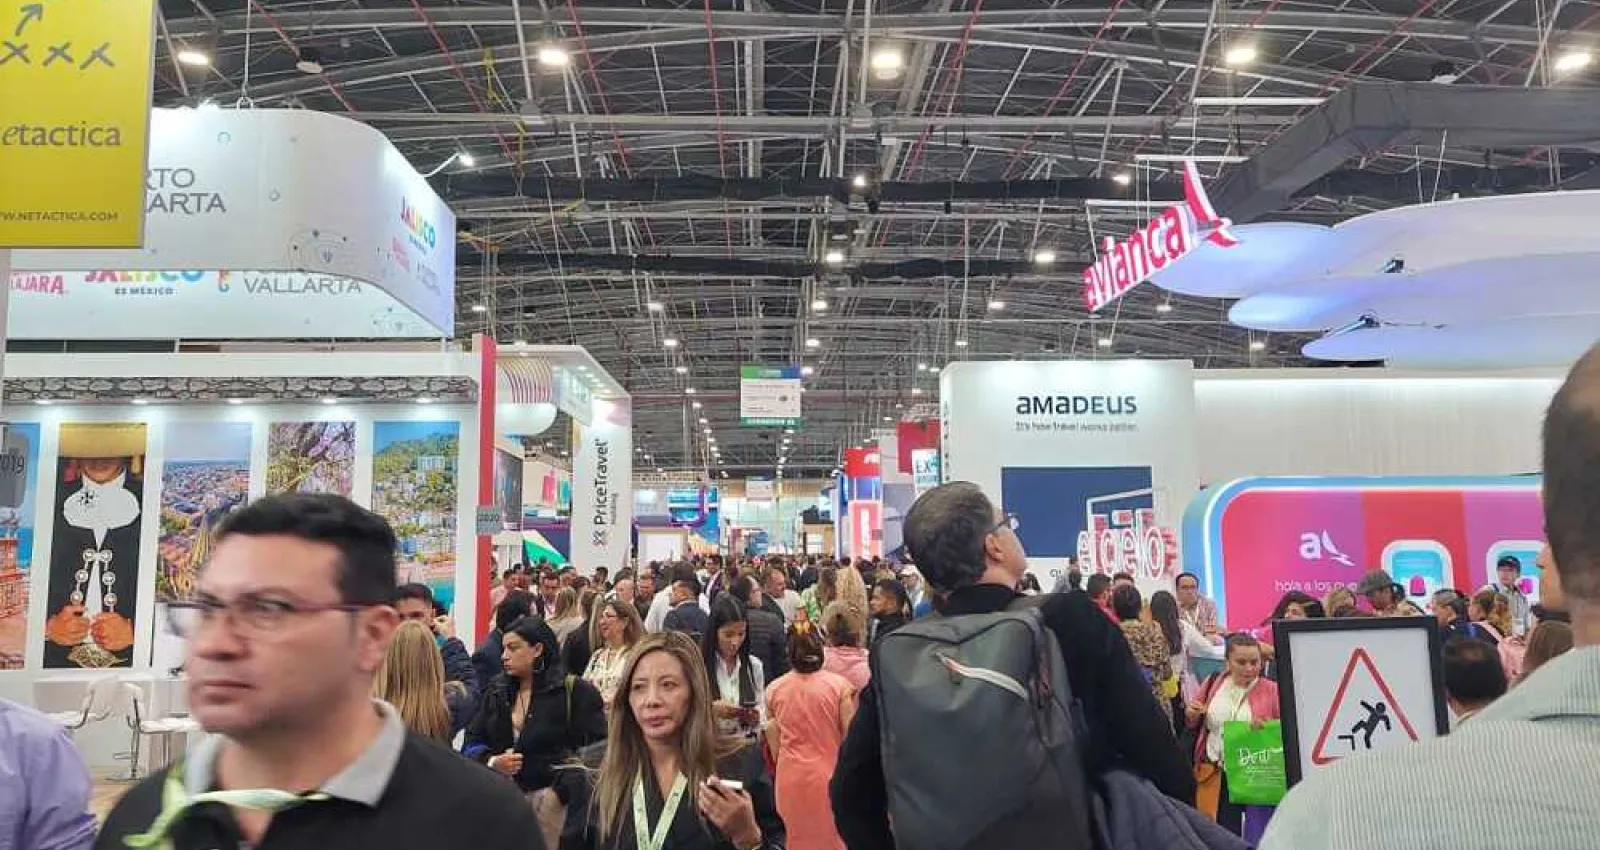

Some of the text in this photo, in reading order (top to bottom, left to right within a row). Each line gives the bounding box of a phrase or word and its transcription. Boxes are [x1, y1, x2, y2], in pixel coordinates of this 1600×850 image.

[146, 192, 227, 214] ARTA
[1083, 206, 1190, 312] avianca
[243, 277, 362, 294] VALLARTA
[0, 453, 25, 474] 019
